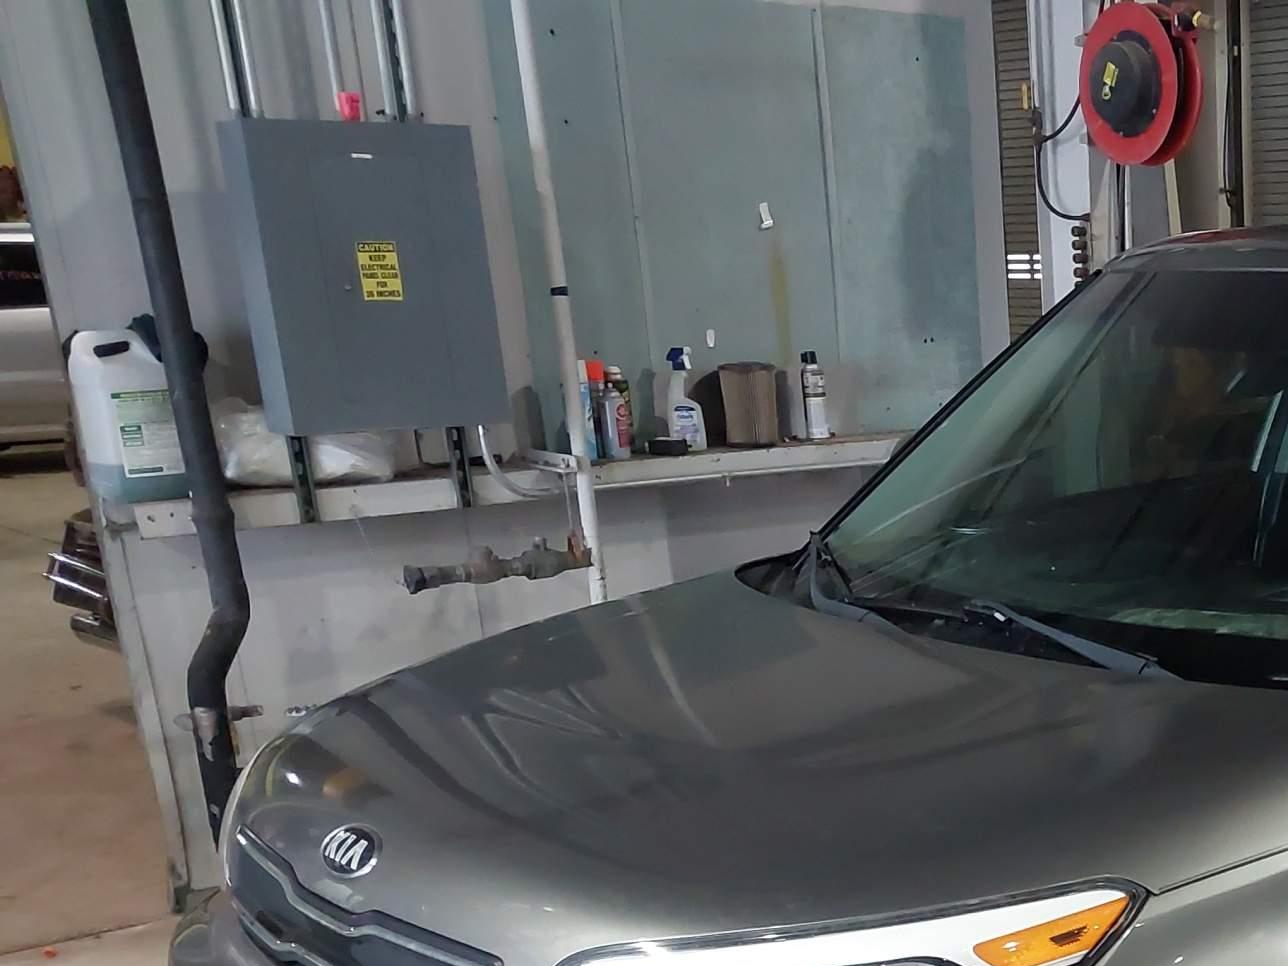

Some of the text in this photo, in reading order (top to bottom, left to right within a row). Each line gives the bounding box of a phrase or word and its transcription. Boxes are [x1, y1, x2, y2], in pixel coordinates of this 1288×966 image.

[358, 243, 395, 252] CAUTION
[369, 254, 387, 262] KEEP
[361, 263, 397, 271] ELECTRICAL
[324, 830, 369, 871] KIA
